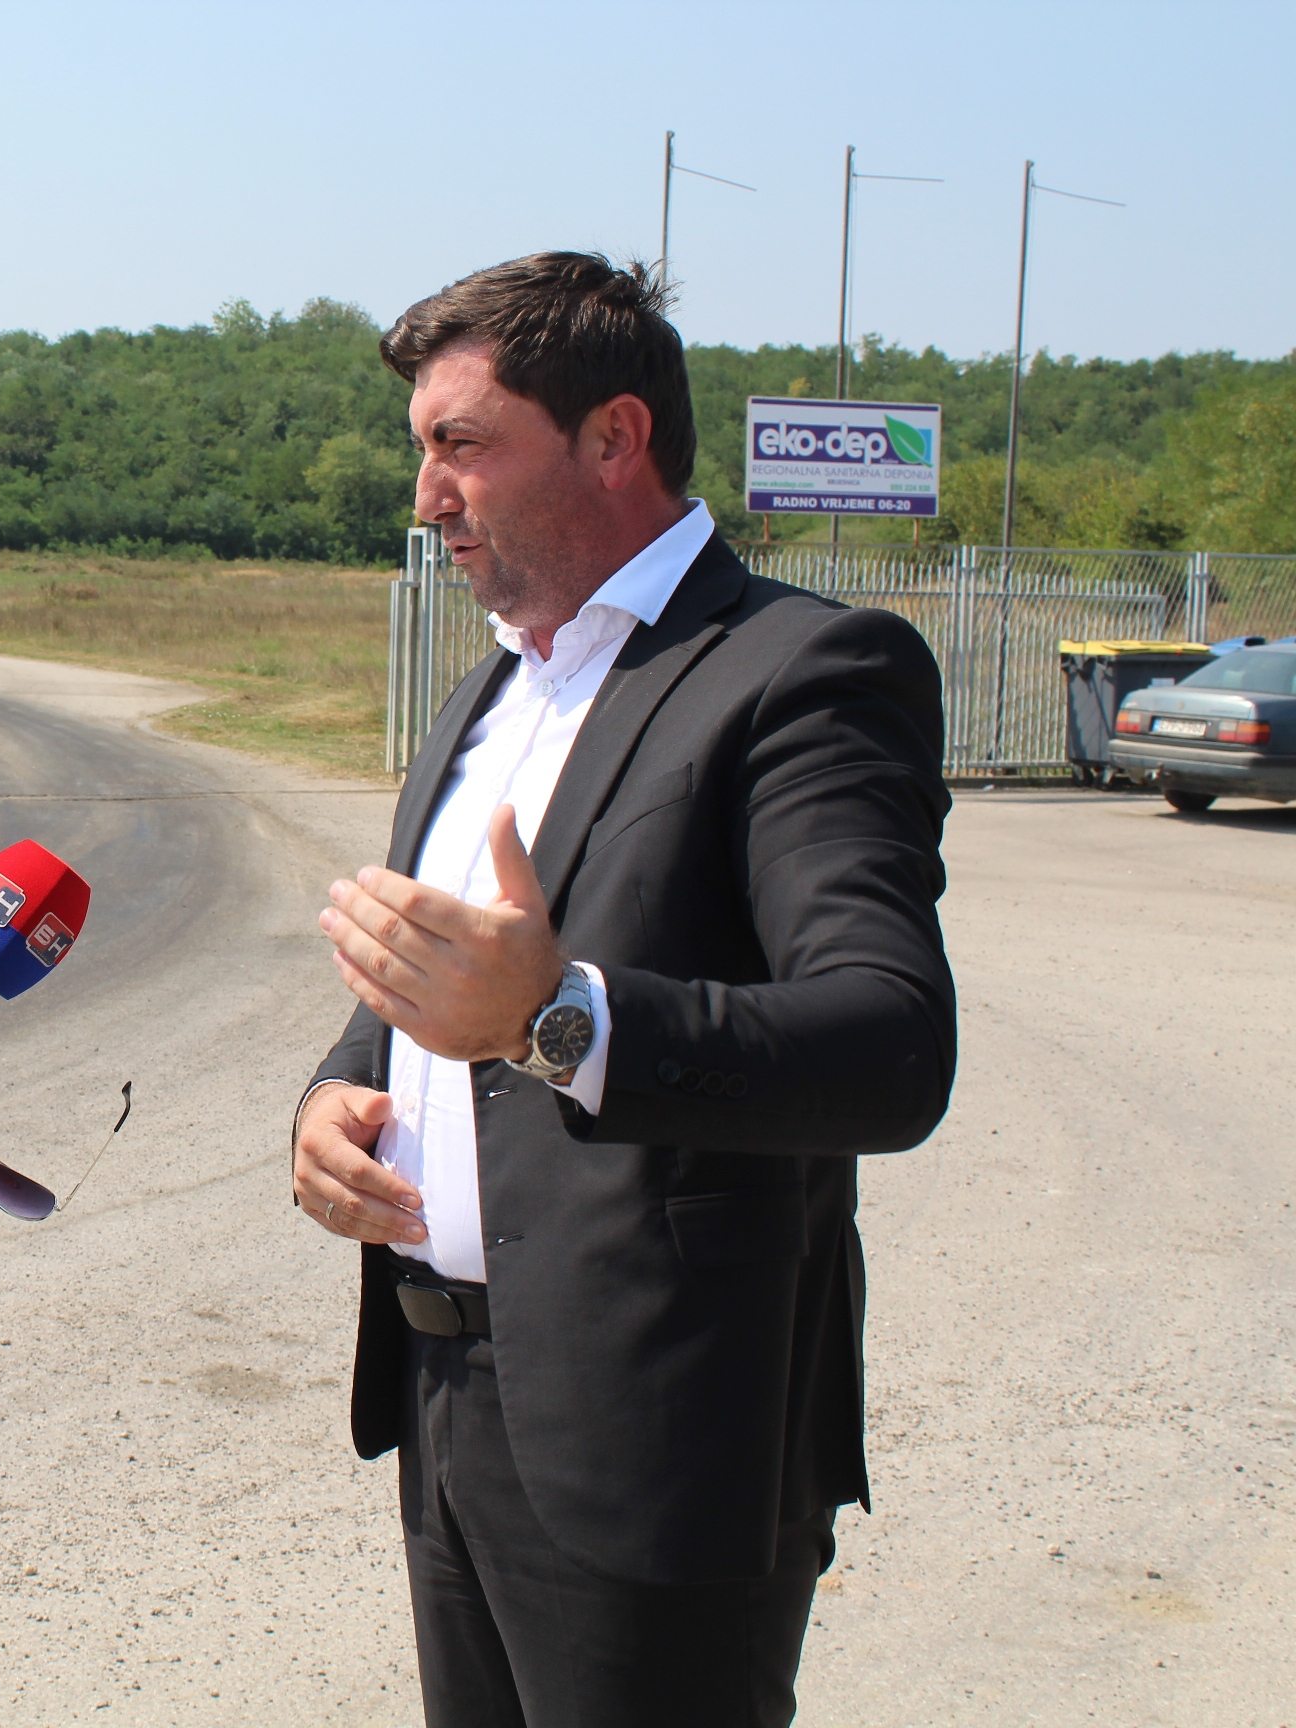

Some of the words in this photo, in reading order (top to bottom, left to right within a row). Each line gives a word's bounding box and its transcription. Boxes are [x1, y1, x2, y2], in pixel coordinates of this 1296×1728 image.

[758, 420, 887, 466] eko-dep
[751, 464, 822, 477] REGIONALNA
[824, 466, 882, 479] SANITARNA
[884, 469, 934, 481] DEPONIJA
[772, 496, 818, 508] RADNO
[820, 497, 876, 509] VRIJEME
[878, 499, 911, 511] 06-20
